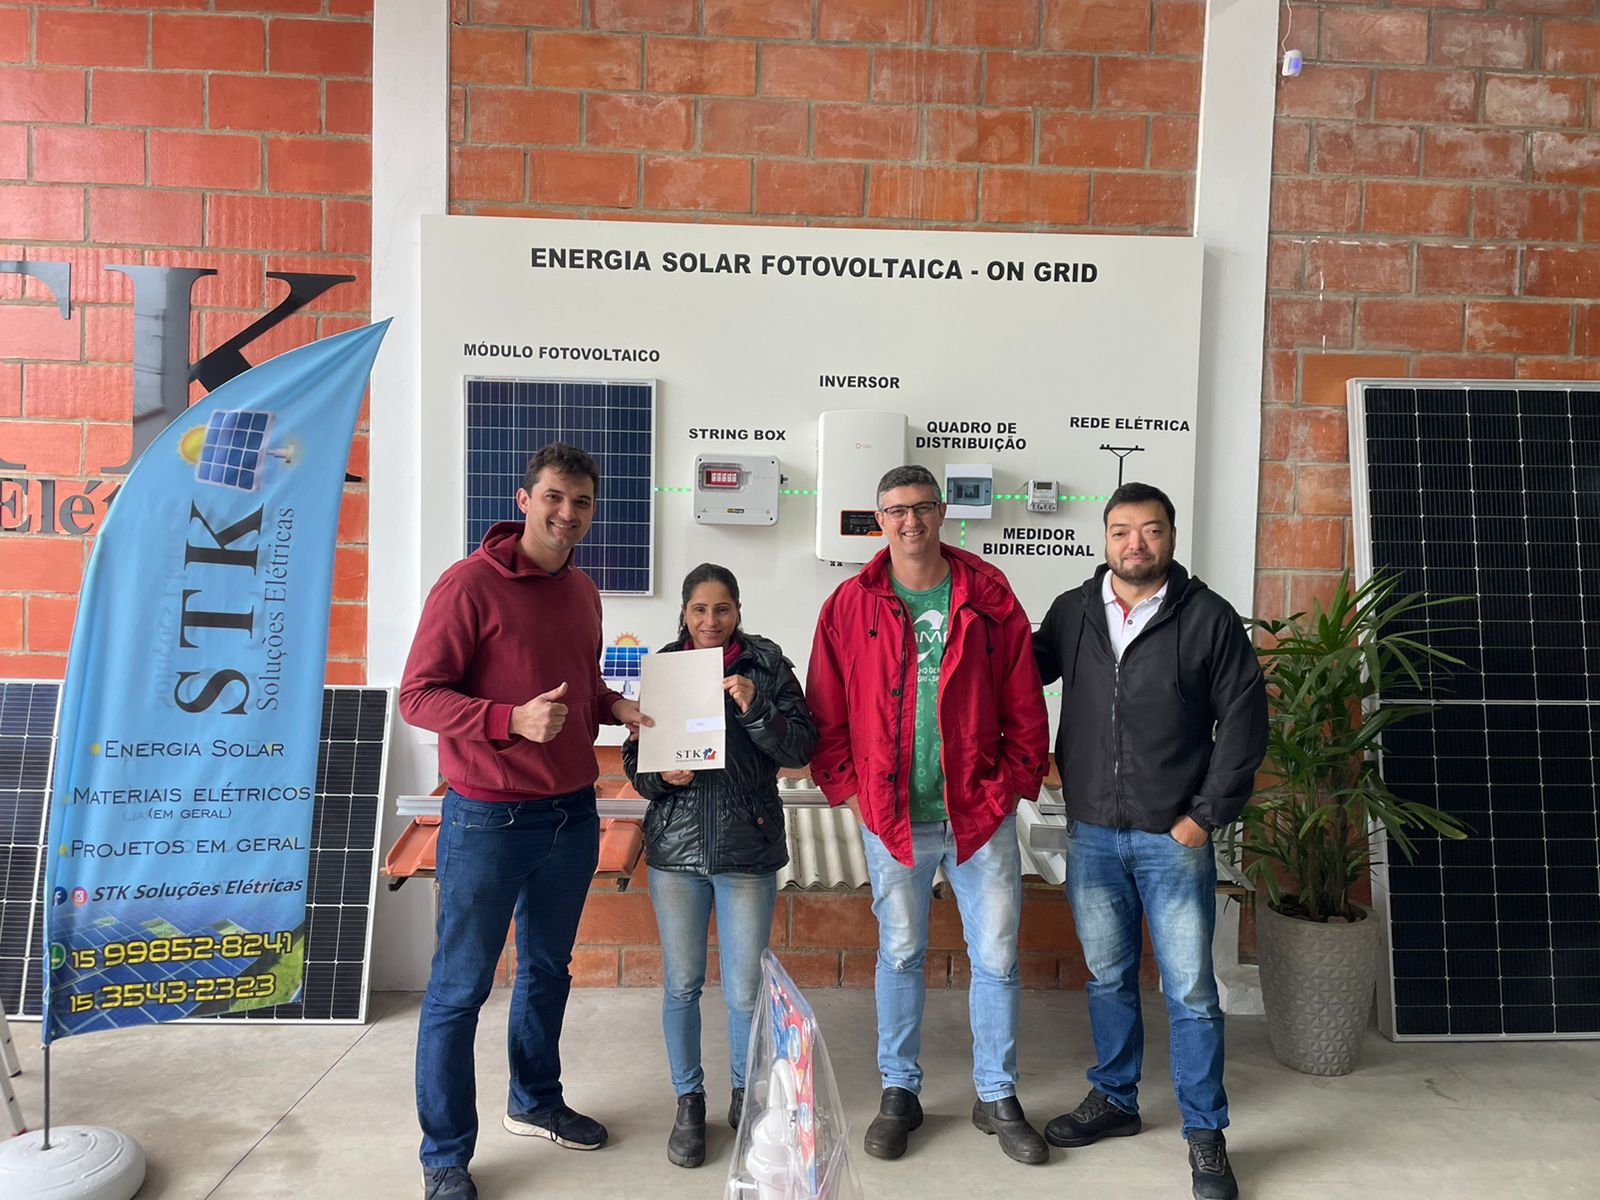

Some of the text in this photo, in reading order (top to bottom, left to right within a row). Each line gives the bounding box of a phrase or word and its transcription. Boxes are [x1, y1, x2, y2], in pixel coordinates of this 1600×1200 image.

[532, 248, 651, 270] ENERGIA
[663, 252, 751, 273] SOLAR
[762, 256, 962, 279] FOTOVOLTAICA
[987, 261, 1024, 281] ON
[1034, 262, 1097, 282] GRID
[465, 342, 659, 362] MÓDULO FOTOVOLTAICO
[820, 376, 899, 388] INVERSOR
[926, 421, 1018, 434] QUADRO DE
[1070, 416, 1189, 431] REDE ELÉTRICA
[689, 429, 785, 440] STRING BOX
[915, 436, 1027, 452] DISTRIBUIÇÃO
[1004, 528, 1075, 540] MEDIDOR
[983, 543, 1095, 557] BIDIRECIONAL
[174, 500, 264, 714] STK
[256, 507, 295, 711] Soluções Elétricas
[676, 749, 702, 759] STK
[92, 879, 303, 902] STK Soluções Elétricas
[71, 931, 293, 970] 15 99852-8241
[69, 974, 277, 1014] 15 3543-2323
